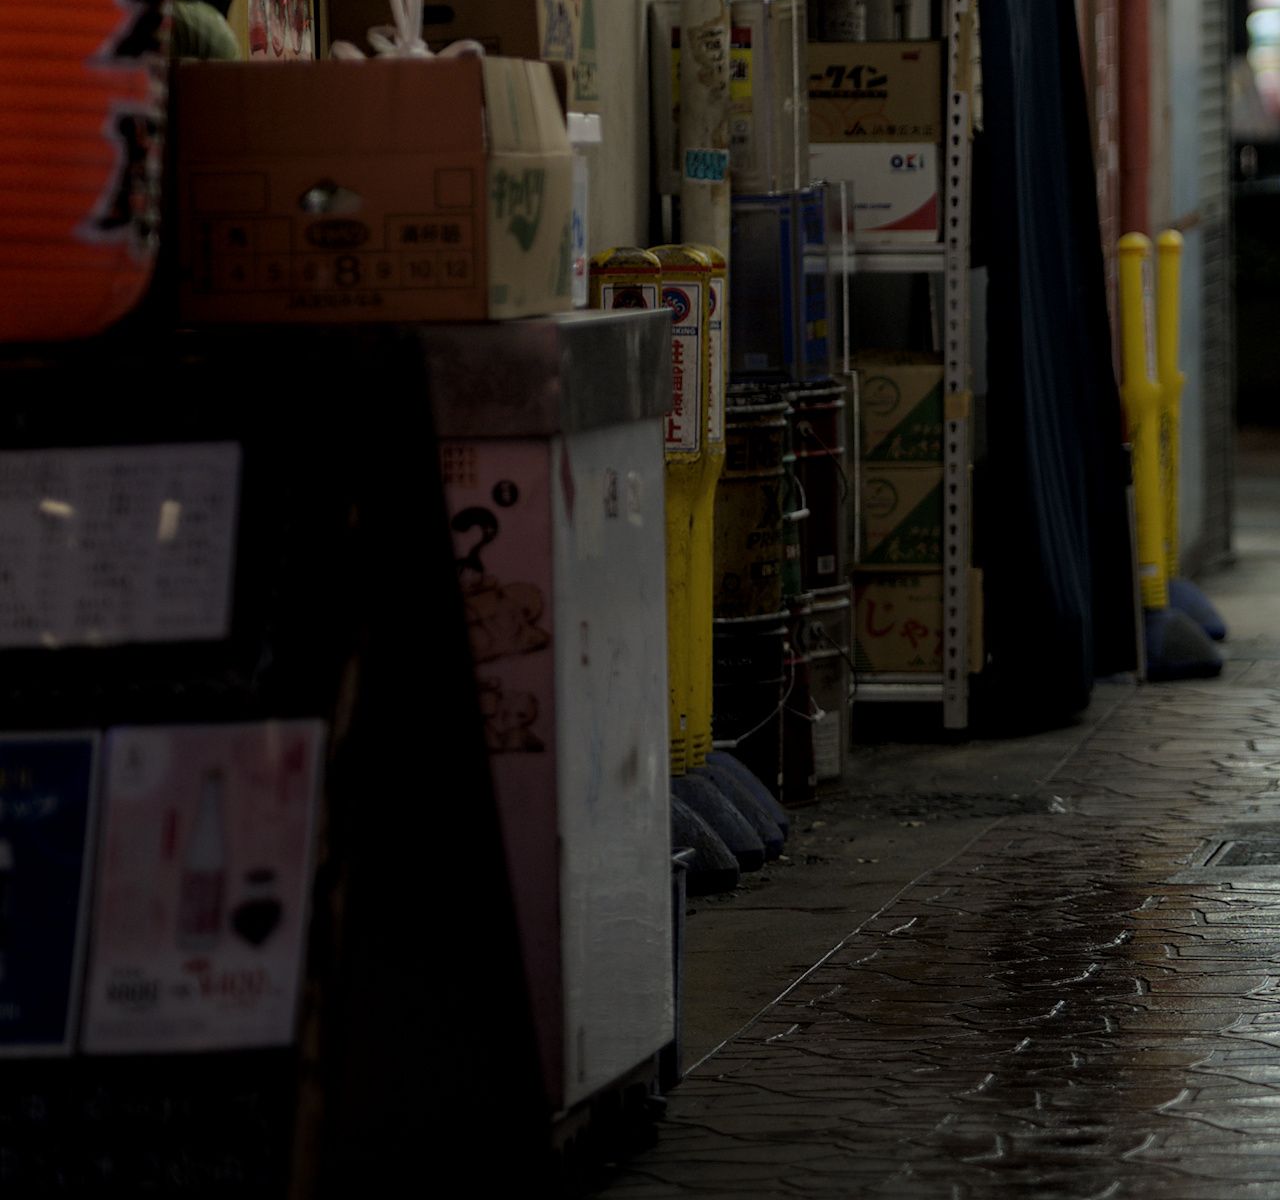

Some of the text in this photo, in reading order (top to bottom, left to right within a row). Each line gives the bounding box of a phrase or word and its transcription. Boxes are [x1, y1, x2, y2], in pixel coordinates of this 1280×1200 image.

[810, 65, 887, 89] ークイン
[335, 254, 360, 287] 8
[866, 599, 944, 656] じゃ
